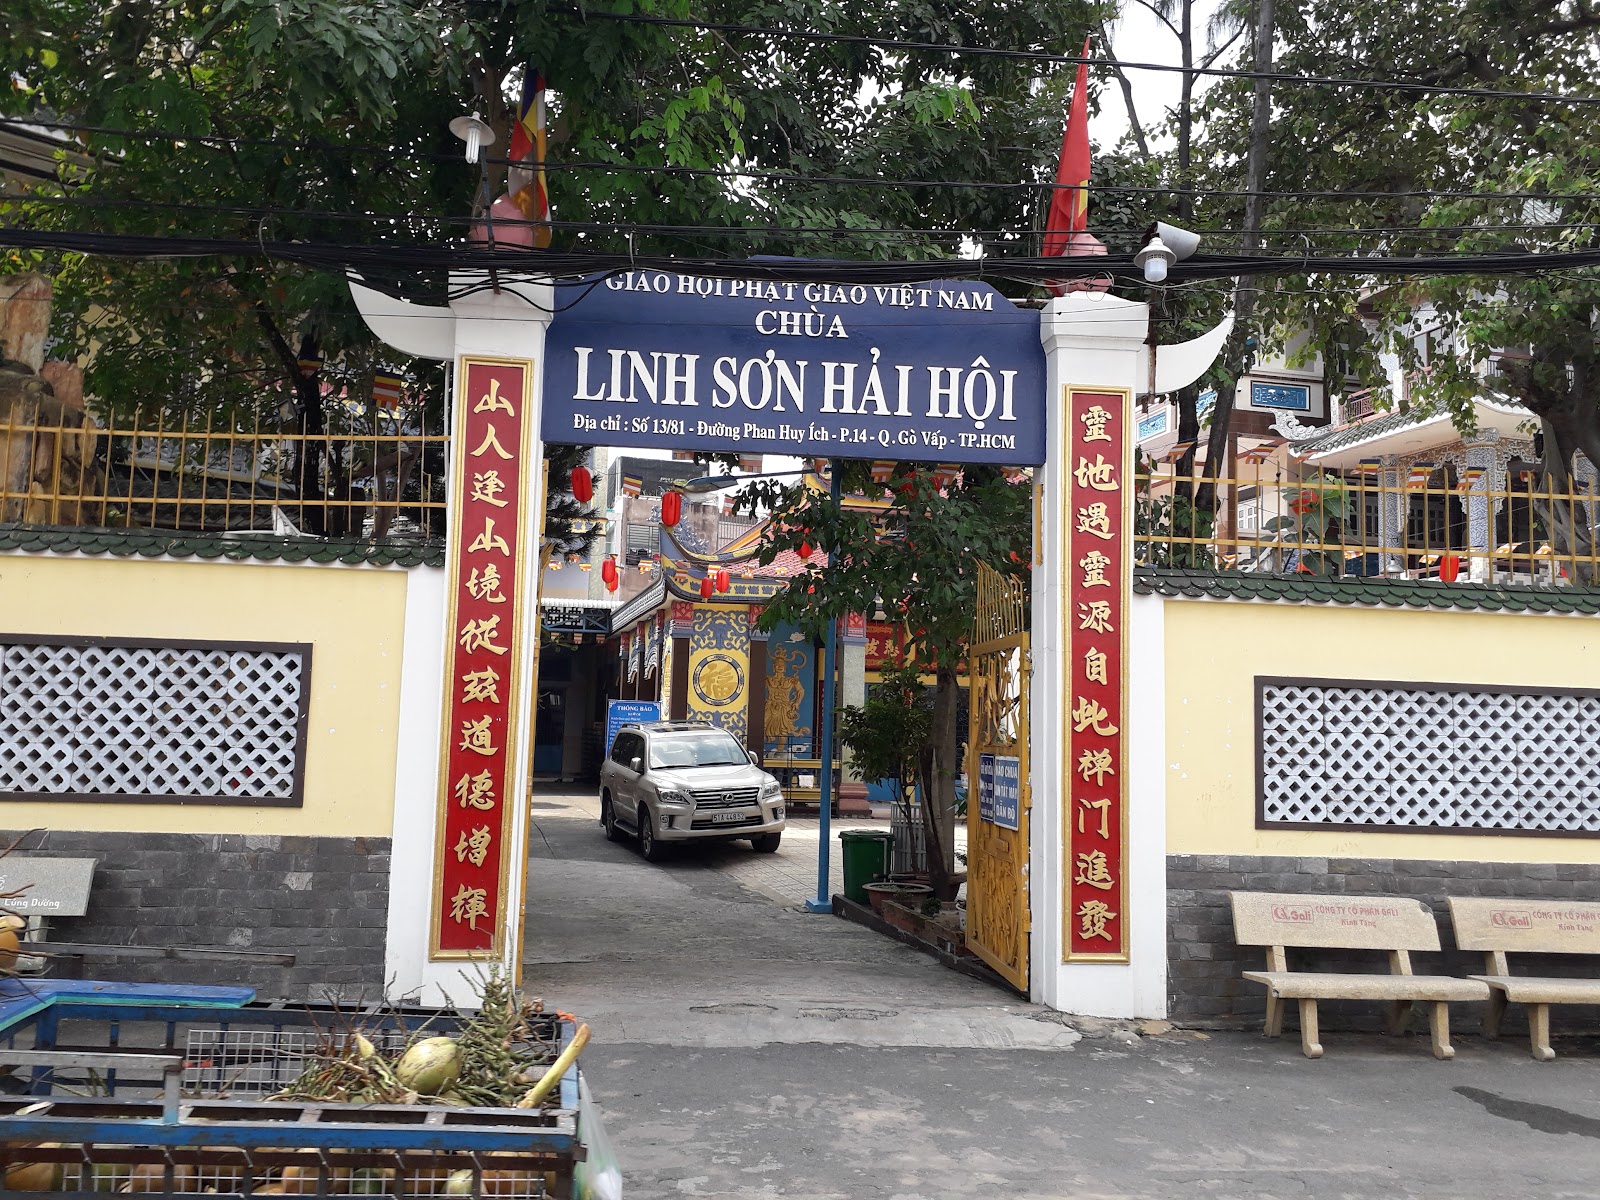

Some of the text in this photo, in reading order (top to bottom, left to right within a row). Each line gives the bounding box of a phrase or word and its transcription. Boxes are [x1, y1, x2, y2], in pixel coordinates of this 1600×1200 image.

[872, 283, 932, 310] VIỆT
[936, 290, 994, 311] NAM
[755, 305, 849, 338] CHÙA
[572, 346, 1018, 430] LINH SƠN HẢI HỘI
[573, 413, 597, 432] Địa
[600, 414, 621, 431] chỉ
[631, 416, 650, 434] Số
[652, 418, 686, 435] 13/81
[697, 420, 741, 441] Đường
[743, 422, 776, 439] Phan
[779, 424, 805, 443] Huy
[808, 421, 829, 441] Ích
[839, 427, 867, 443] P.14
[921, 429, 947, 450] Vấp
[958, 432, 1016, 449] TP.HCM
[1336, 906, 1346, 915] TY
[1553, 911, 1562, 920] TY
